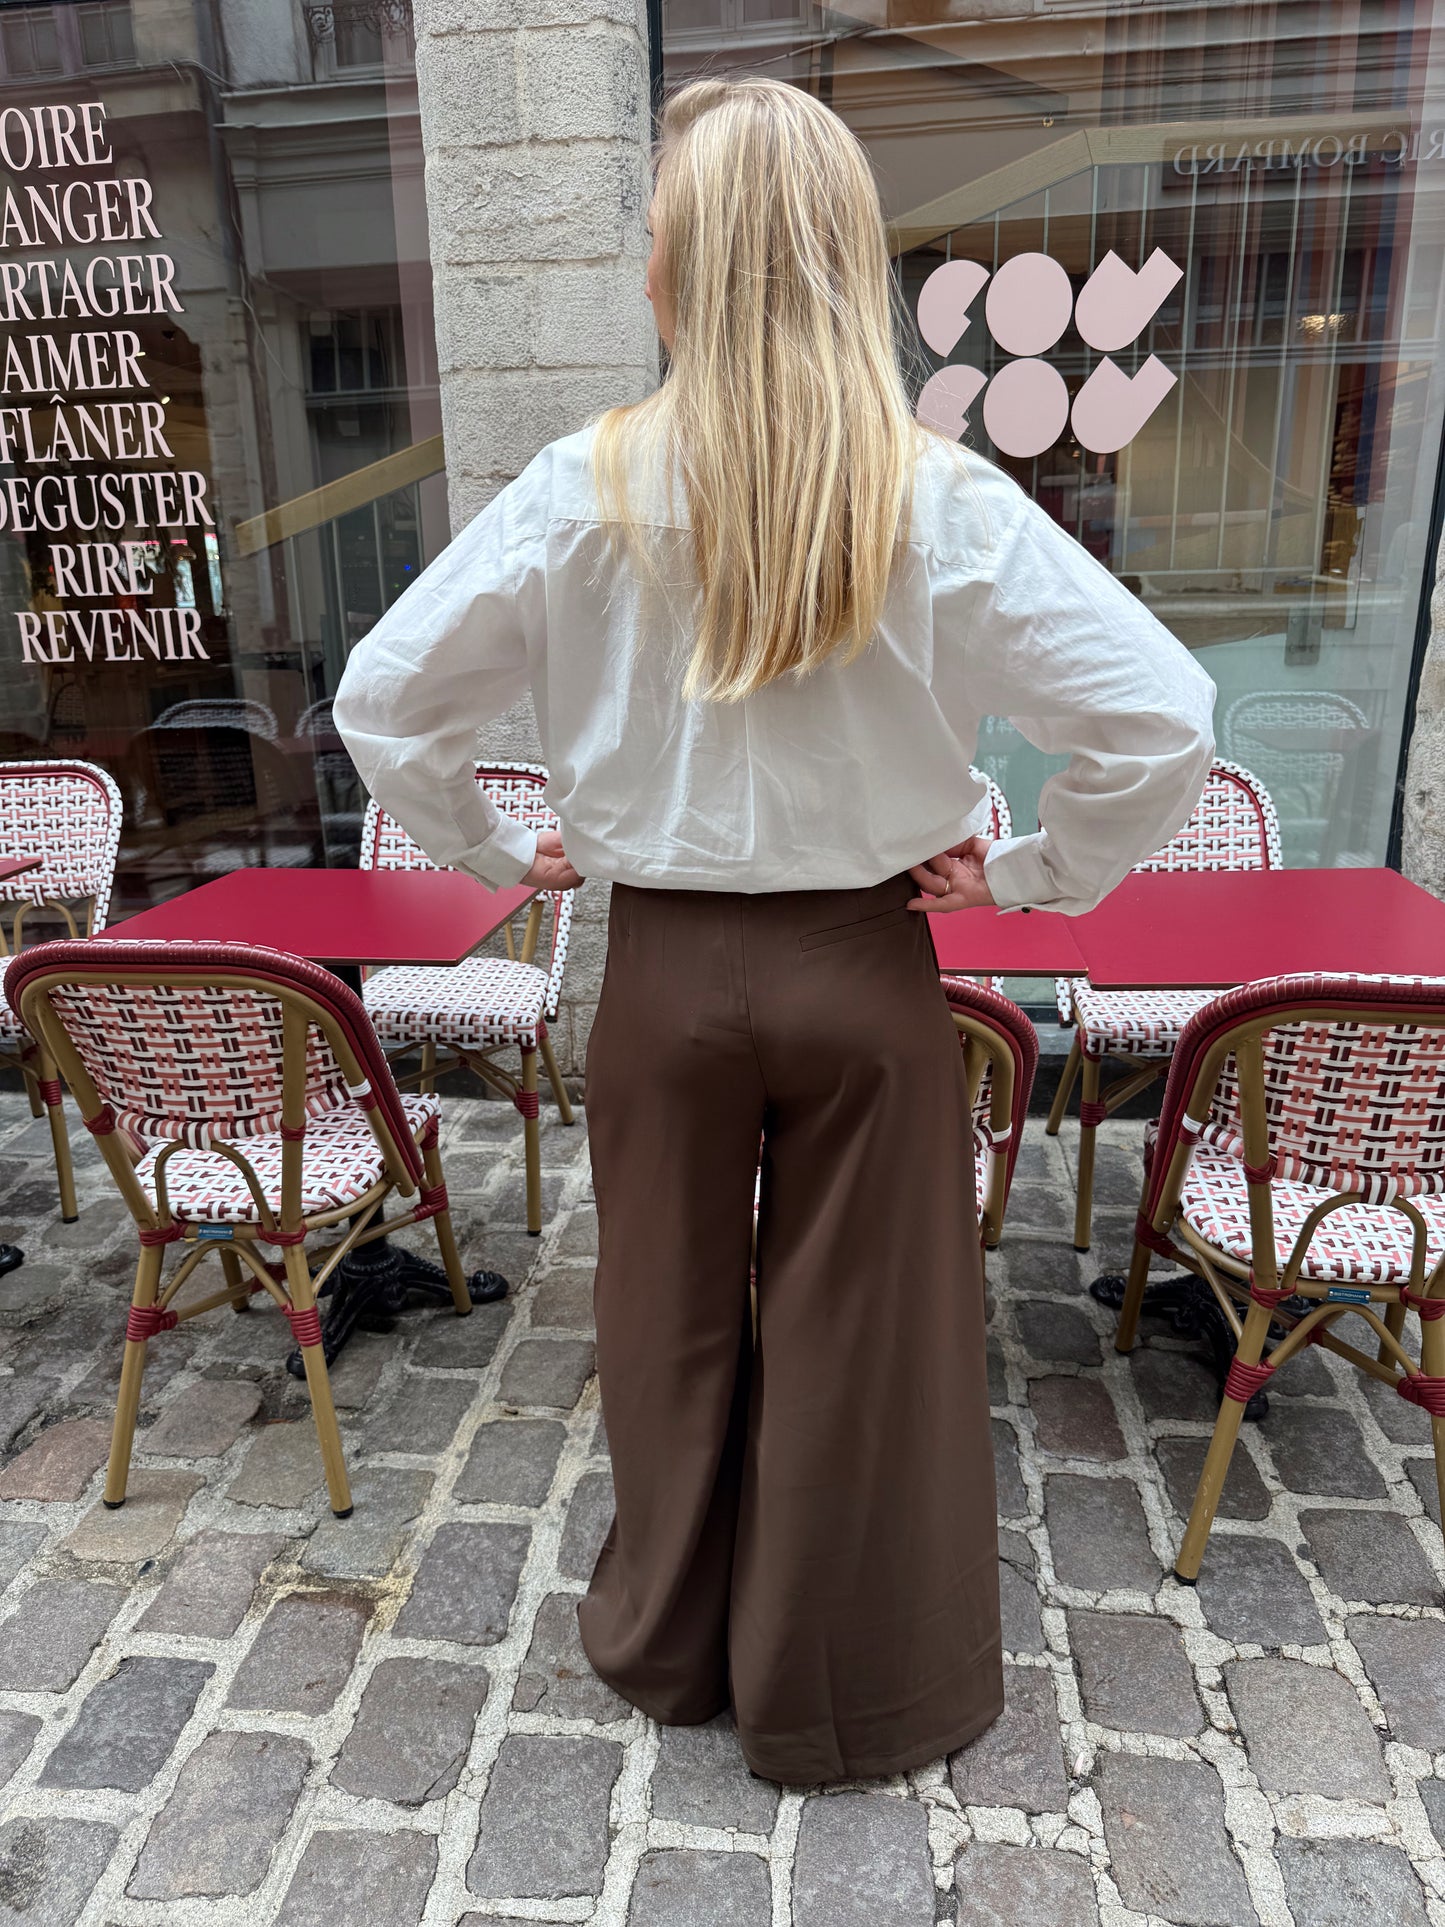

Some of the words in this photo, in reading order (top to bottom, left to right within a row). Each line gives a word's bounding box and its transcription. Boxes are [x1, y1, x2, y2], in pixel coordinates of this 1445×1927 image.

[0, 102, 113, 171] OIRE
[0, 178, 162, 248] ANGER
[0, 253, 184, 321] RTAGER
[1, 330, 150, 394] AIMER
[0, 394, 175, 463] FLÂNER
[48, 542, 153, 597] RIRE
[14, 608, 210, 663] REVENIR
